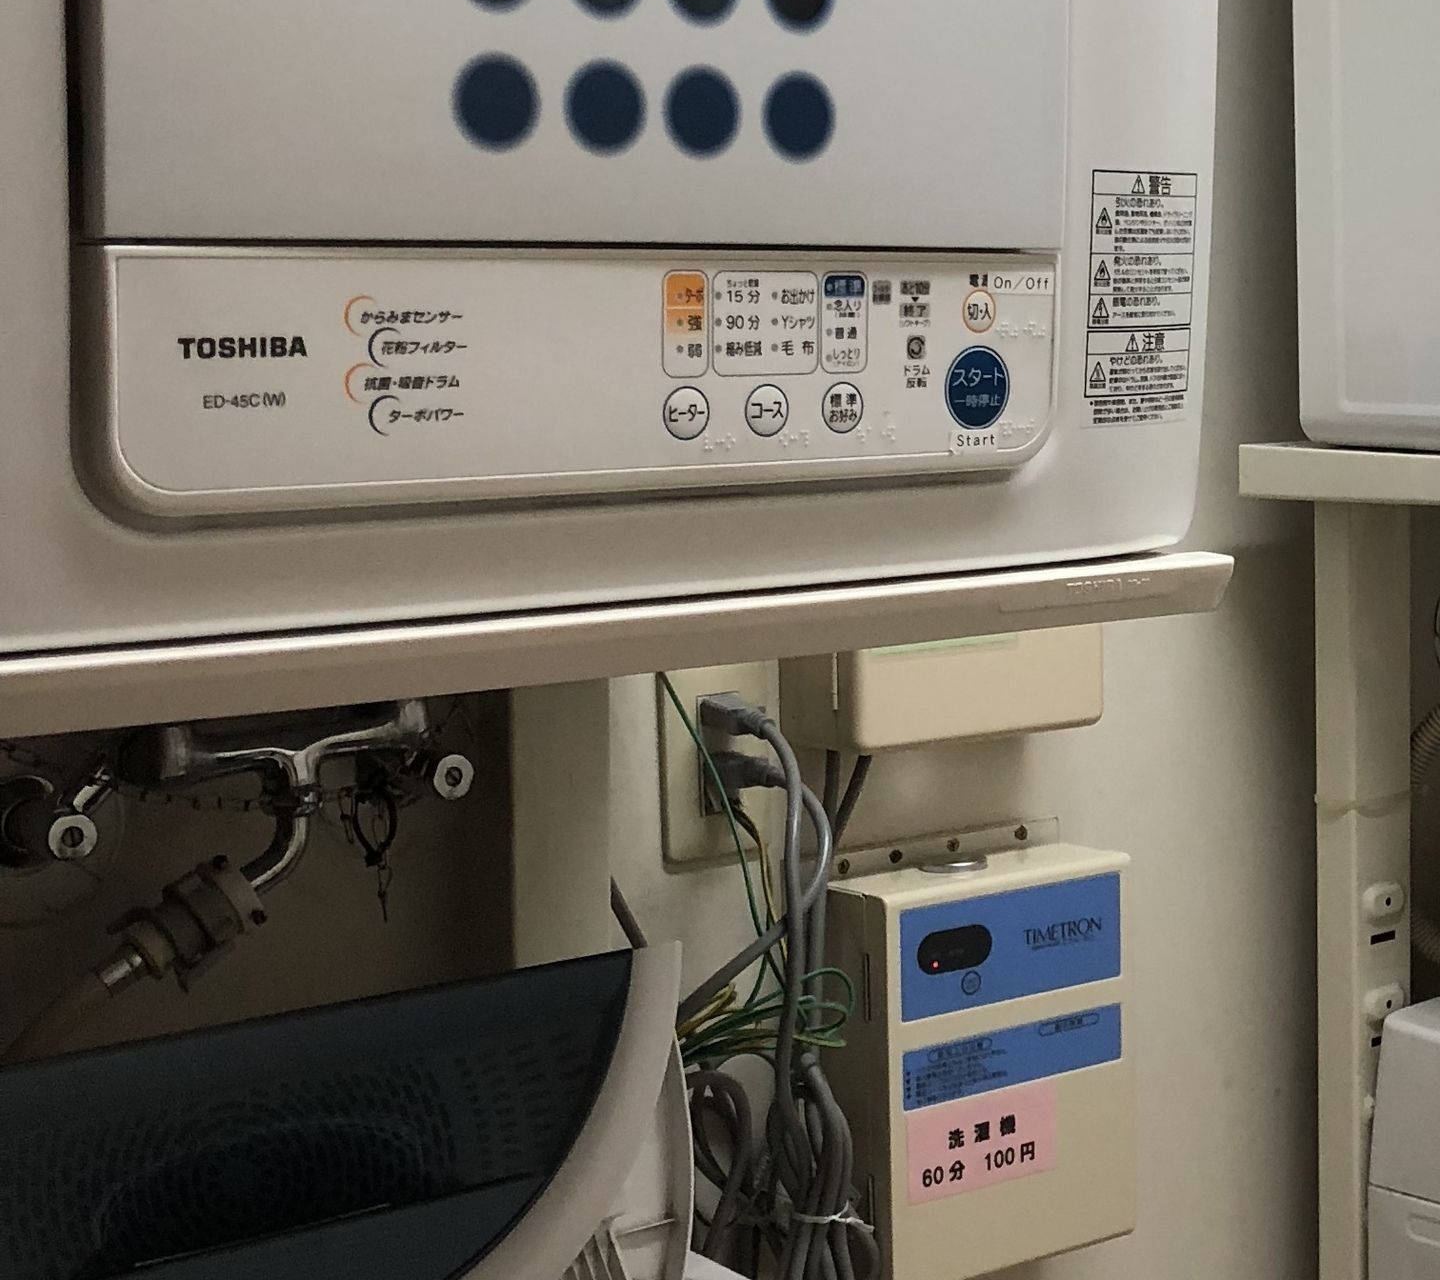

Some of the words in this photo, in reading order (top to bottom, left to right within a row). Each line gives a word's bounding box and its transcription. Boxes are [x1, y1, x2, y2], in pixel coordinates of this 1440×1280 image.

[1148, 175, 1172, 196] 警告
[726, 290, 761, 304] 15分
[360, 310, 463, 325] からみまセンサー
[687, 315, 703, 331] 強
[726, 315, 760, 331] 90分
[177, 336, 308, 359] TOSHIBA
[781, 339, 816, 356] 毛布
[1142, 332, 1166, 352] 注意
[904, 364, 931, 377] ドラム
[952, 367, 1005, 387] スタート
[953, 393, 1001, 408] 一時停止
[388, 407, 465, 424] ターボパワー
[668, 404, 706, 423] ヒーター
[751, 401, 784, 420] コース
[829, 409, 858, 424] お好み
[956, 434, 996, 448] Start
[1022, 917, 1104, 946] TIMETRON
[948, 1114, 1017, 1150] 洗濯機
[922, 1159, 966, 1188] 60分
[984, 1141, 1036, 1172] 100円
